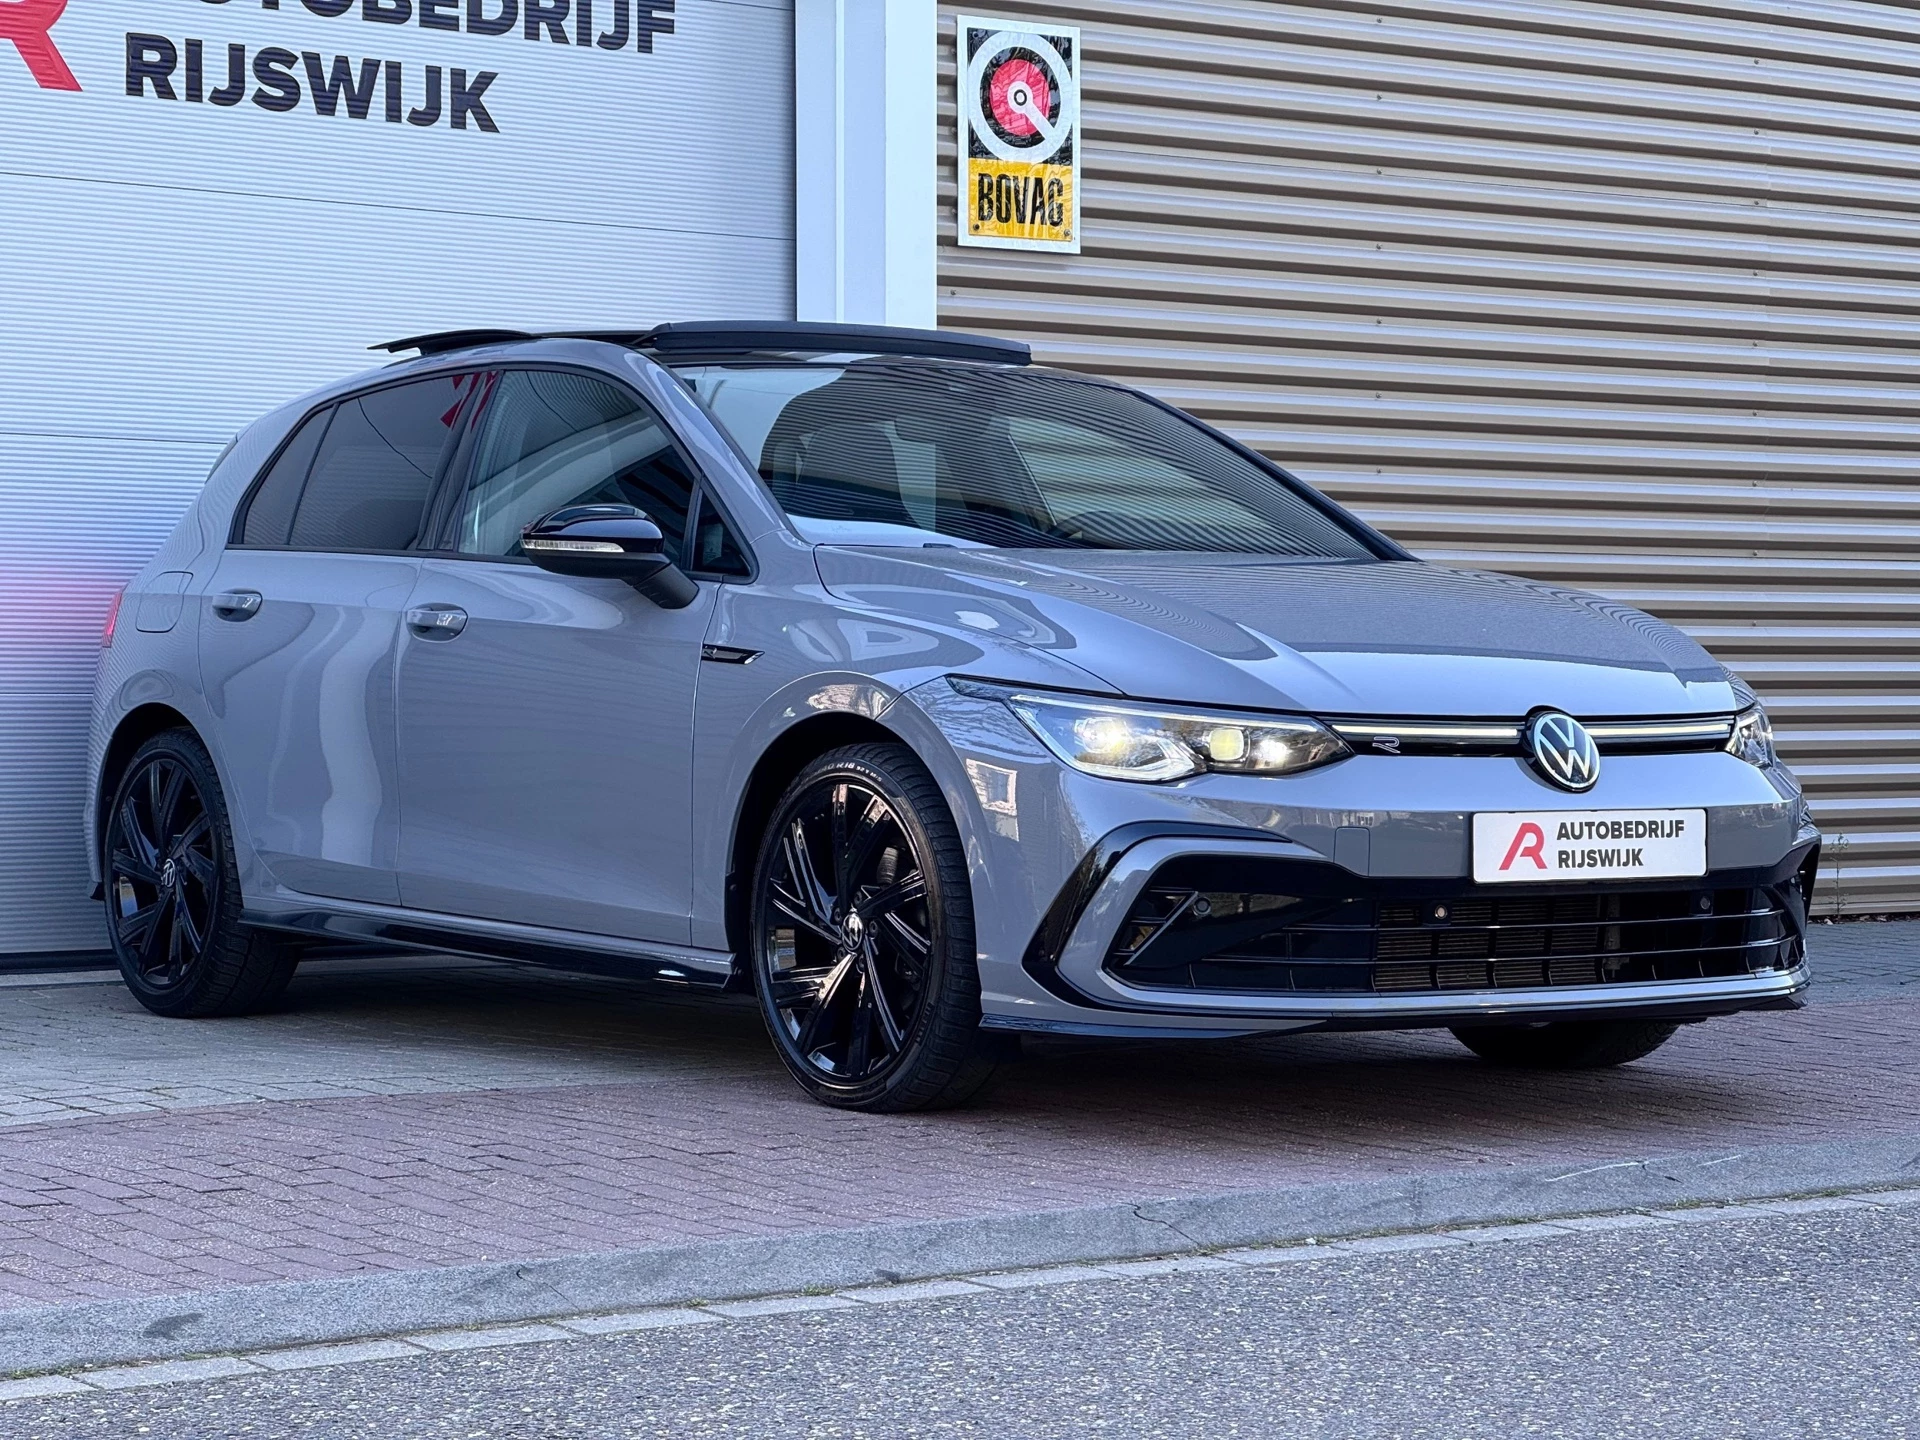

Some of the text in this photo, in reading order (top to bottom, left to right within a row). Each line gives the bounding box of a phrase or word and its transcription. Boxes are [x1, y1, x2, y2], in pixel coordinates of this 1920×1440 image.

[203, 0, 676, 54] EDRIJF
[125, 32, 500, 133] RIJSWIJK
[977, 172, 1064, 228] BOVAG
[1556, 820, 1685, 841] AUTOBEDRIJF
[1558, 848, 1644, 868] RIJSWIJK
